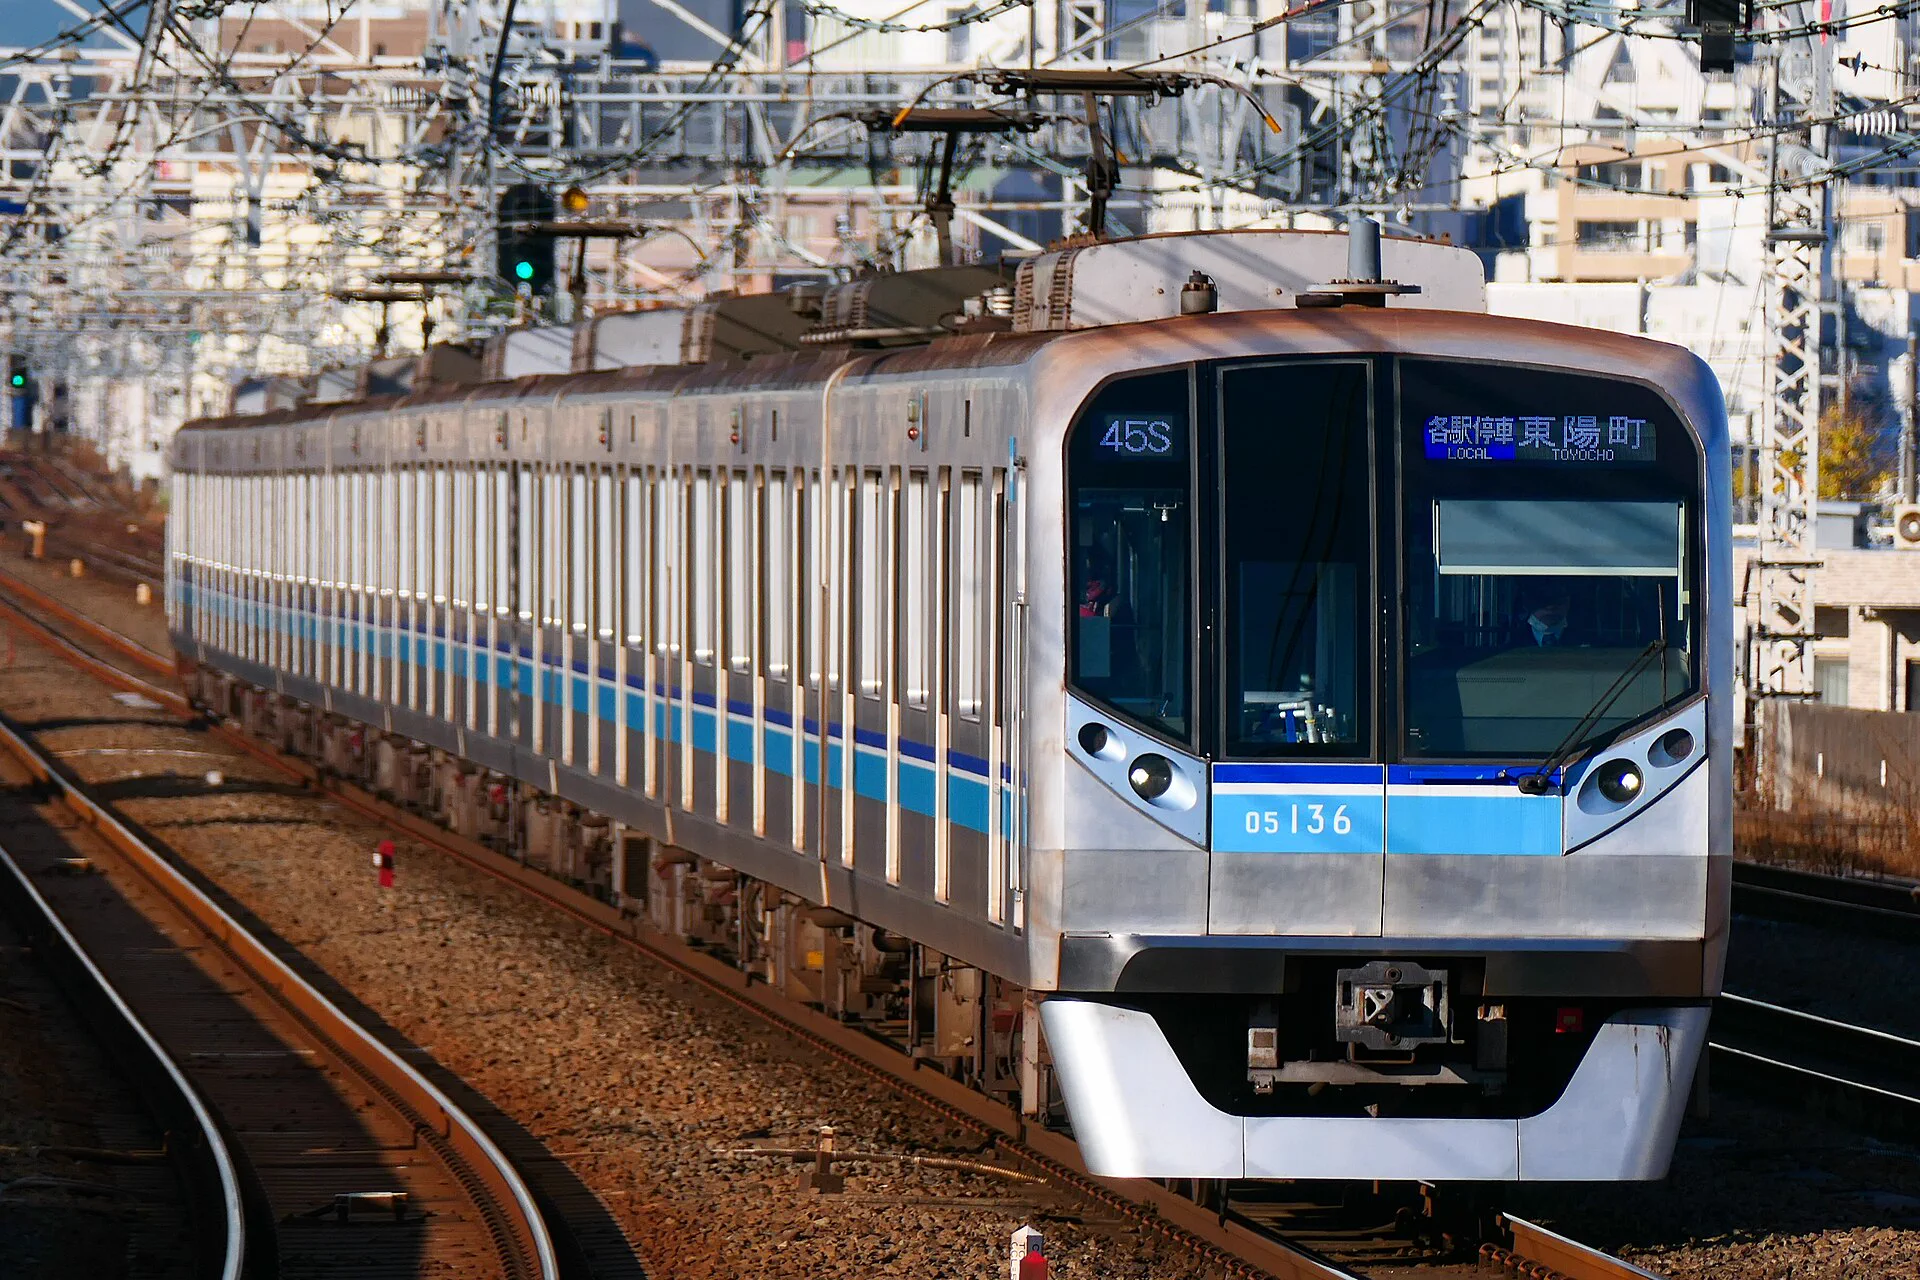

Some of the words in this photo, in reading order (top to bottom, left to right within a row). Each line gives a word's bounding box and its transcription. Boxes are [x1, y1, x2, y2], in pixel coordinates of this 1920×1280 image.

[1100, 420, 1171, 452] 45S
[1428, 415, 1514, 445] 各駅停車
[1518, 416, 1647, 449] 東陽町
[1447, 447, 1493, 460] LOCAL
[1552, 448, 1614, 461] TOYOCHO
